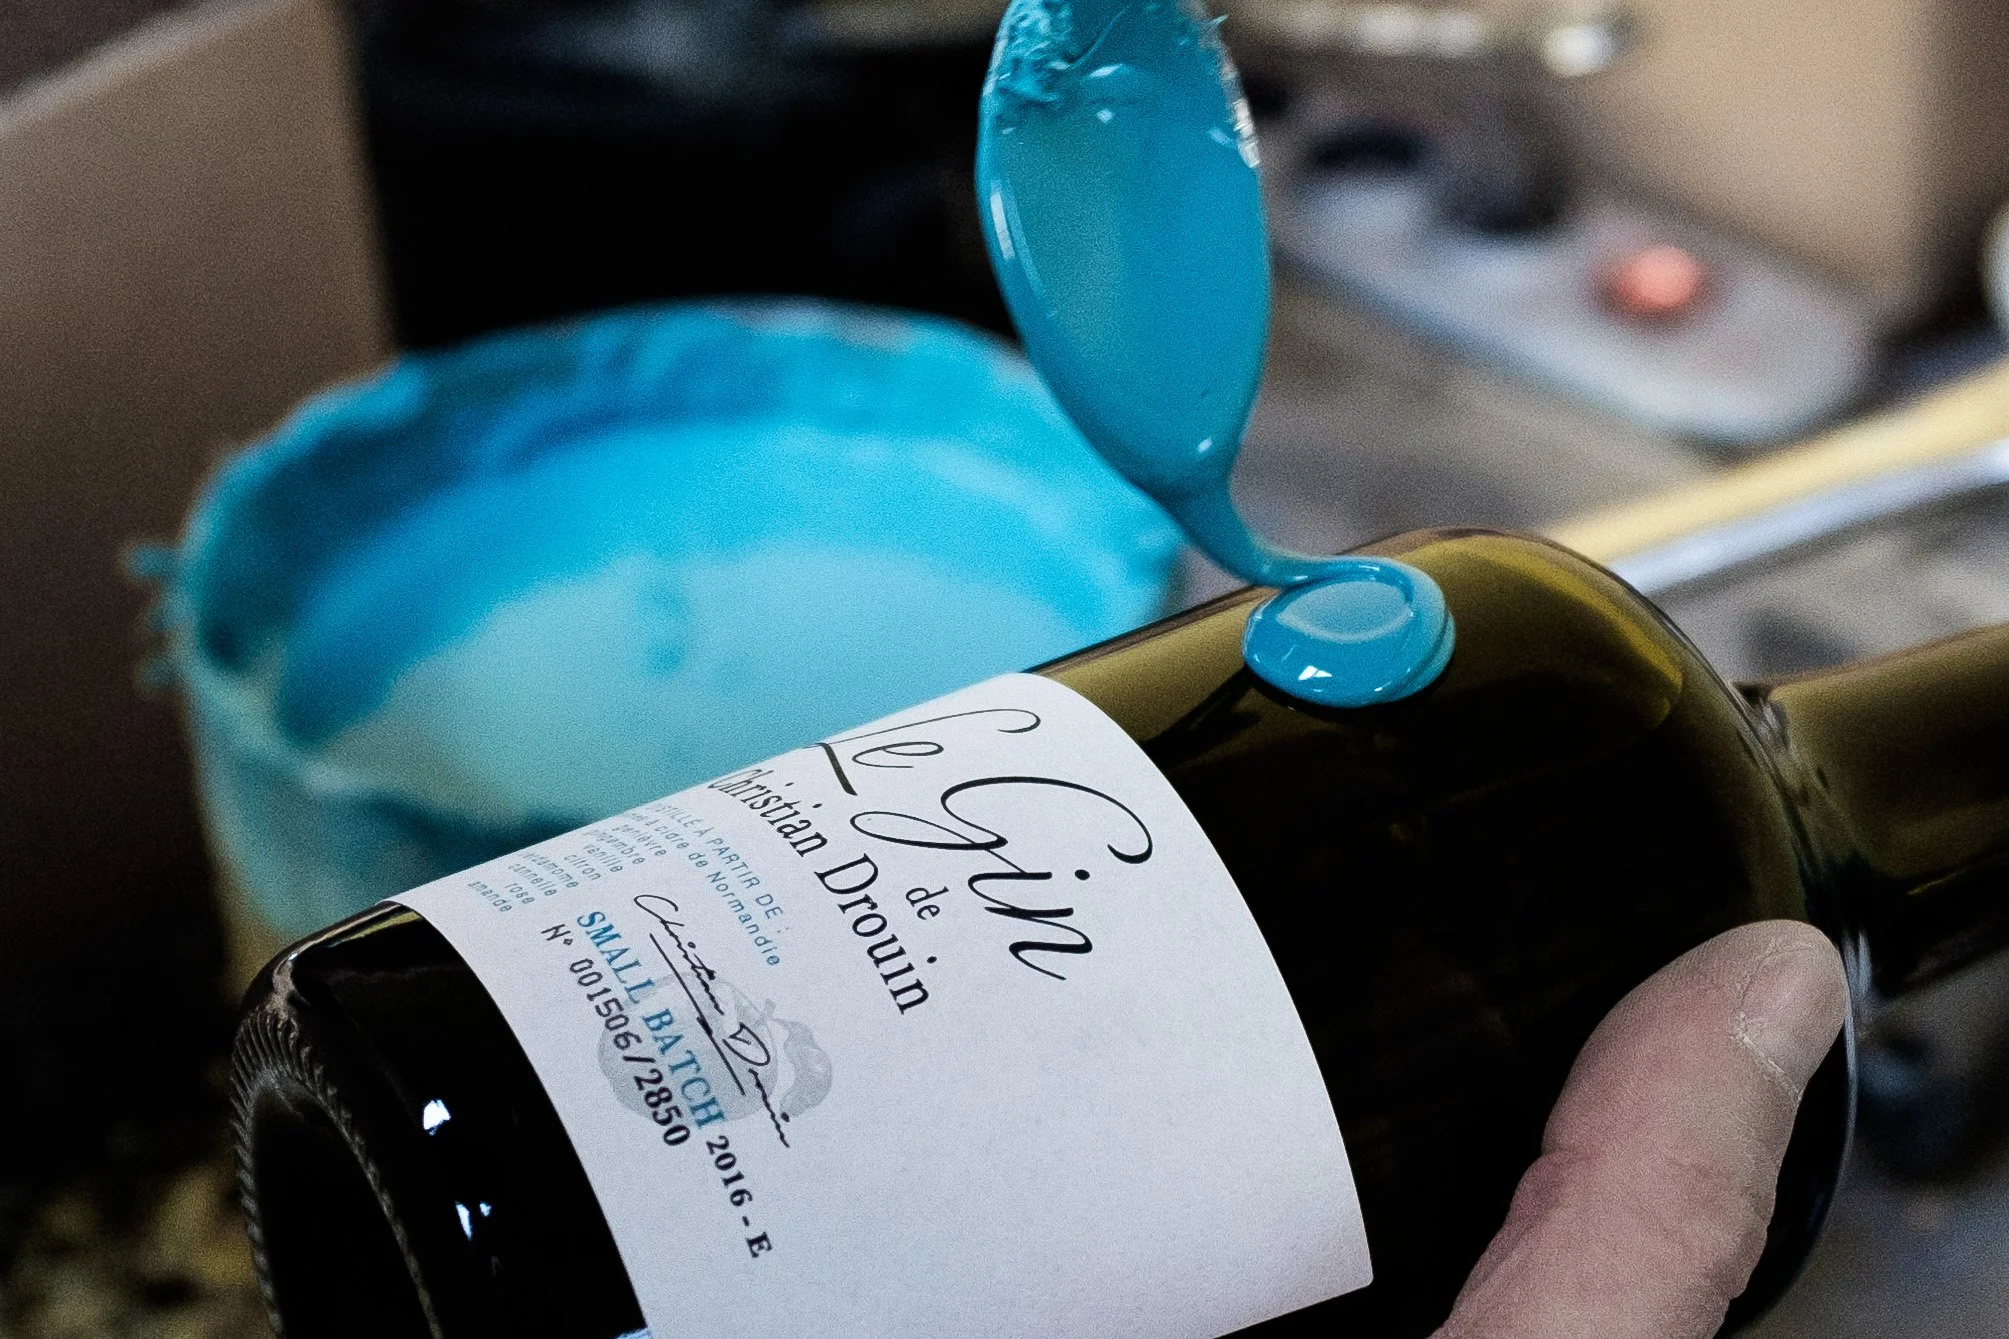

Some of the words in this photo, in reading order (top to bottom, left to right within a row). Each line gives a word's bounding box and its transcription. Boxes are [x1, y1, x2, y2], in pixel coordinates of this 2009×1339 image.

[802, 708, 1041, 796] Le
[468, 881, 512, 912] amande
[504, 882, 535, 905] rose
[507, 863, 558, 896] cannelle
[564, 854, 601, 881] citron
[583, 843, 624, 873] vanille
[706, 838, 760, 889] PARTIR
[756, 894, 784, 919] DE
[707, 768, 828, 857] Christian
[814, 853, 938, 1015] Drouin
[850, 776, 1153, 980] Gin
[688, 852, 709, 868] de
[706, 871, 780, 966] Normandie
[905, 886, 949, 920] de
[569, 958, 692, 1147] 001506/2850
[577, 911, 655, 1005] SMALL
[641, 1008, 726, 1129] BATCH
[706, 1135, 753, 1207] 2016
[745, 1231, 773, 1258] E
